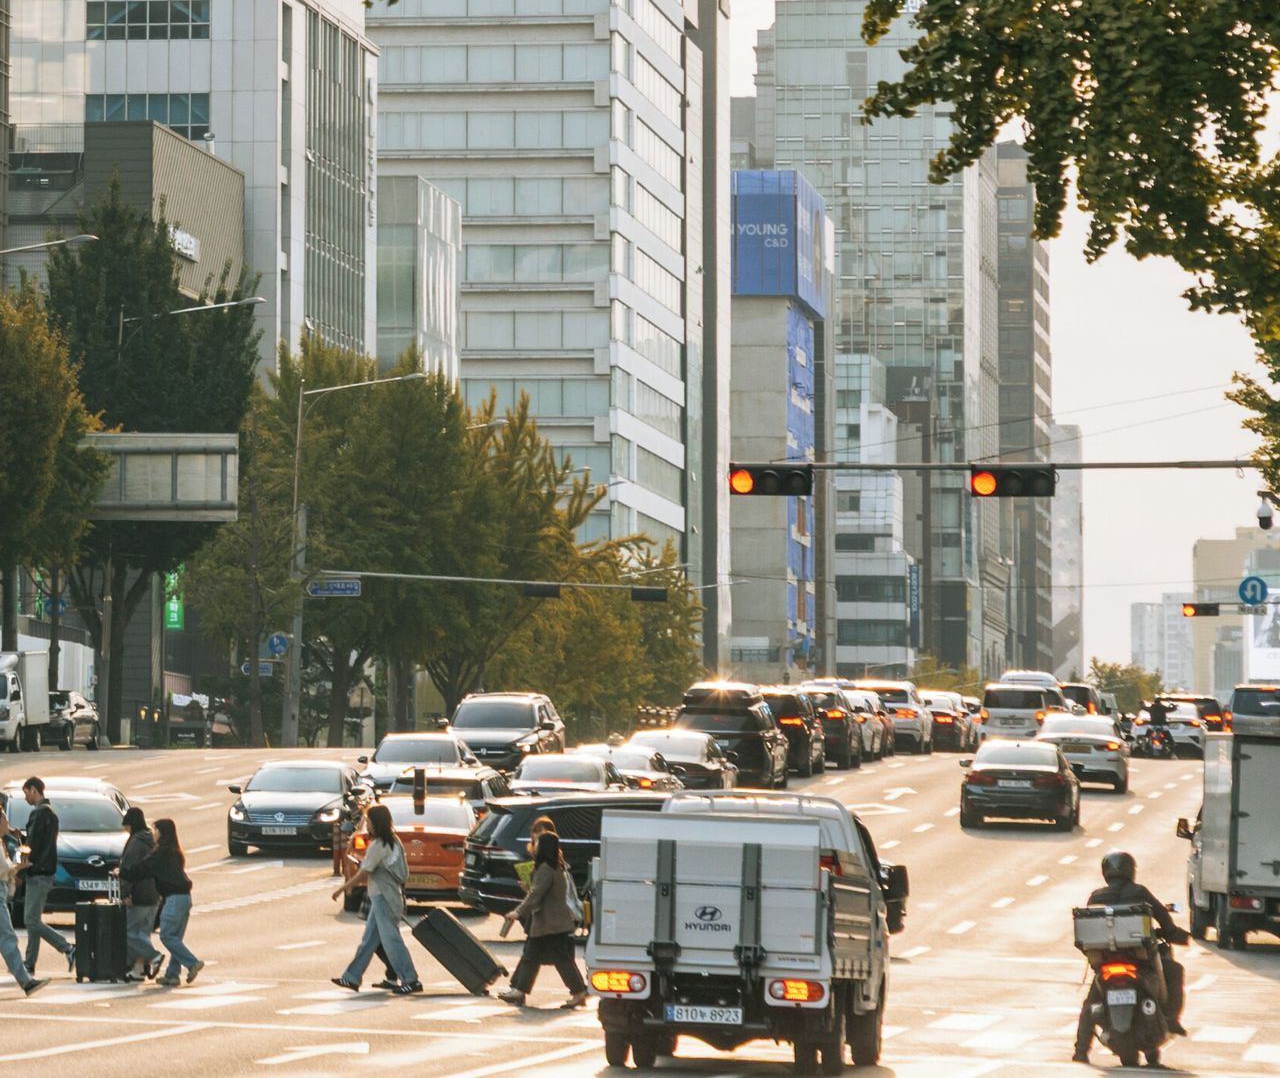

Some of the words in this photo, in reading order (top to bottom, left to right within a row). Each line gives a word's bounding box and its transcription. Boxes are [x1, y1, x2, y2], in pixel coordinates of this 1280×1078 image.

[764, 238, 789, 248] C&D
[685, 922, 732, 932] HYUNDAI
[709, 1009, 740, 1022] 8923
